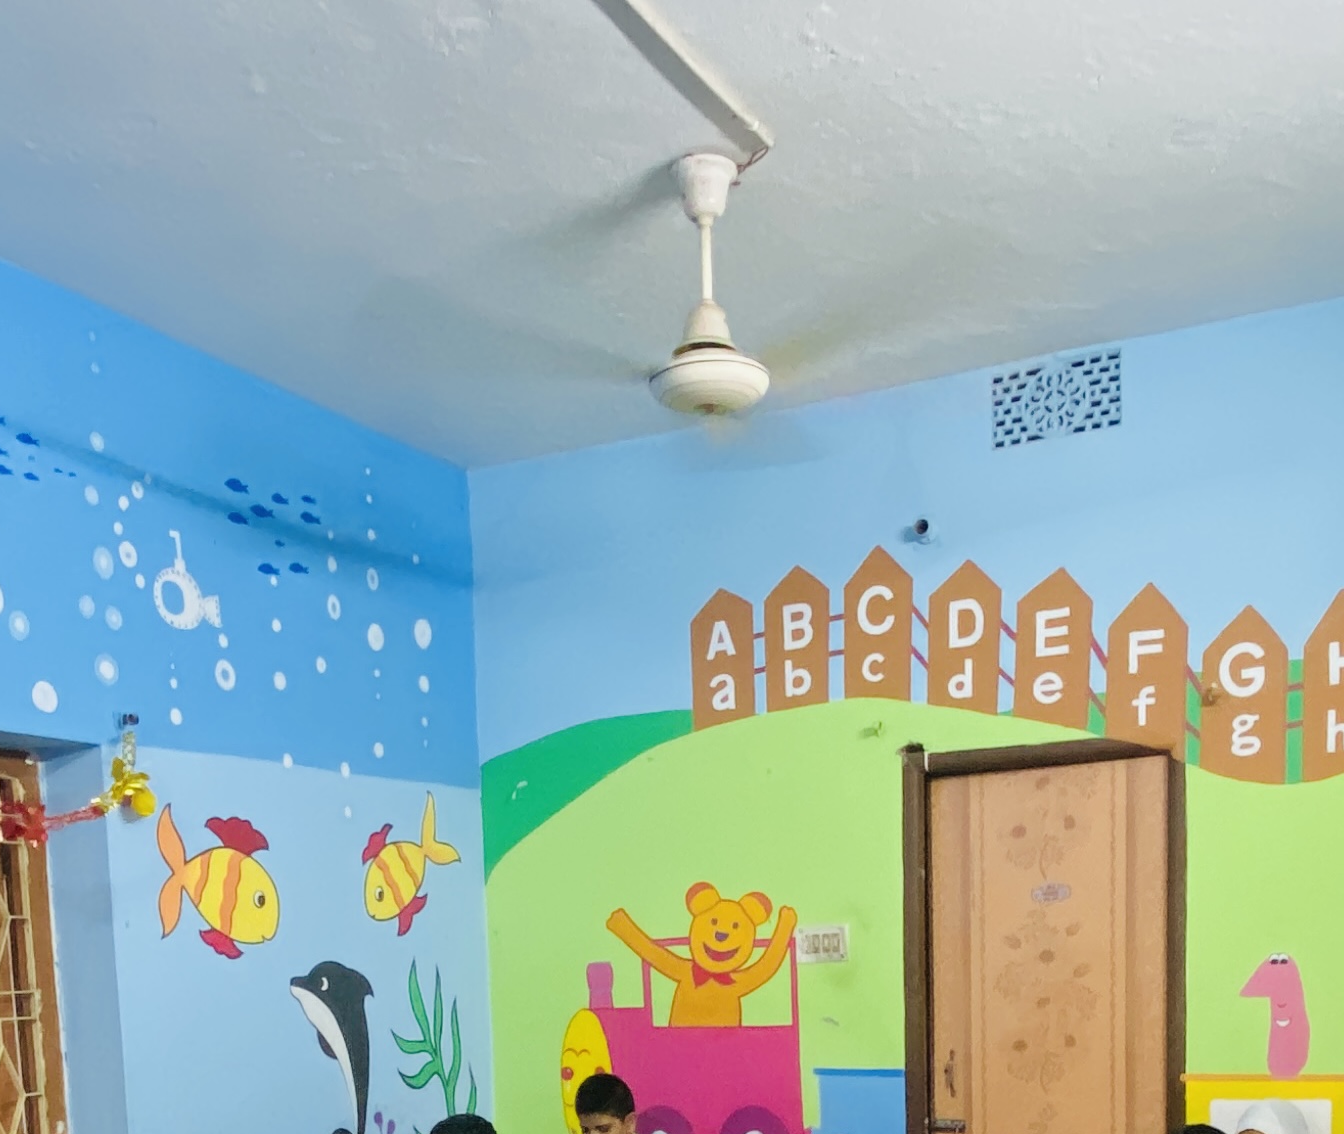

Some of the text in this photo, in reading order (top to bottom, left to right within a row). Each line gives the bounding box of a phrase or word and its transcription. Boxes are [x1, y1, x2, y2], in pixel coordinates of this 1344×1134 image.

[707, 621, 736, 660] A
[783, 603, 813, 650] B
[857, 585, 895, 635] C
[949, 599, 984, 648] D
[1036, 607, 1070, 657] E
[1129, 629, 1164, 673] F
[1218, 642, 1265, 697] G
[710, 674, 735, 710] a
[785, 660, 811, 697] b
[862, 653, 884, 682] c
[948, 659, 972, 698] d
[1033, 672, 1063, 704] e
[1132, 686, 1155, 726] f
[1231, 714, 1261, 756] g
[1239, 952, 1309, 1078] 1
